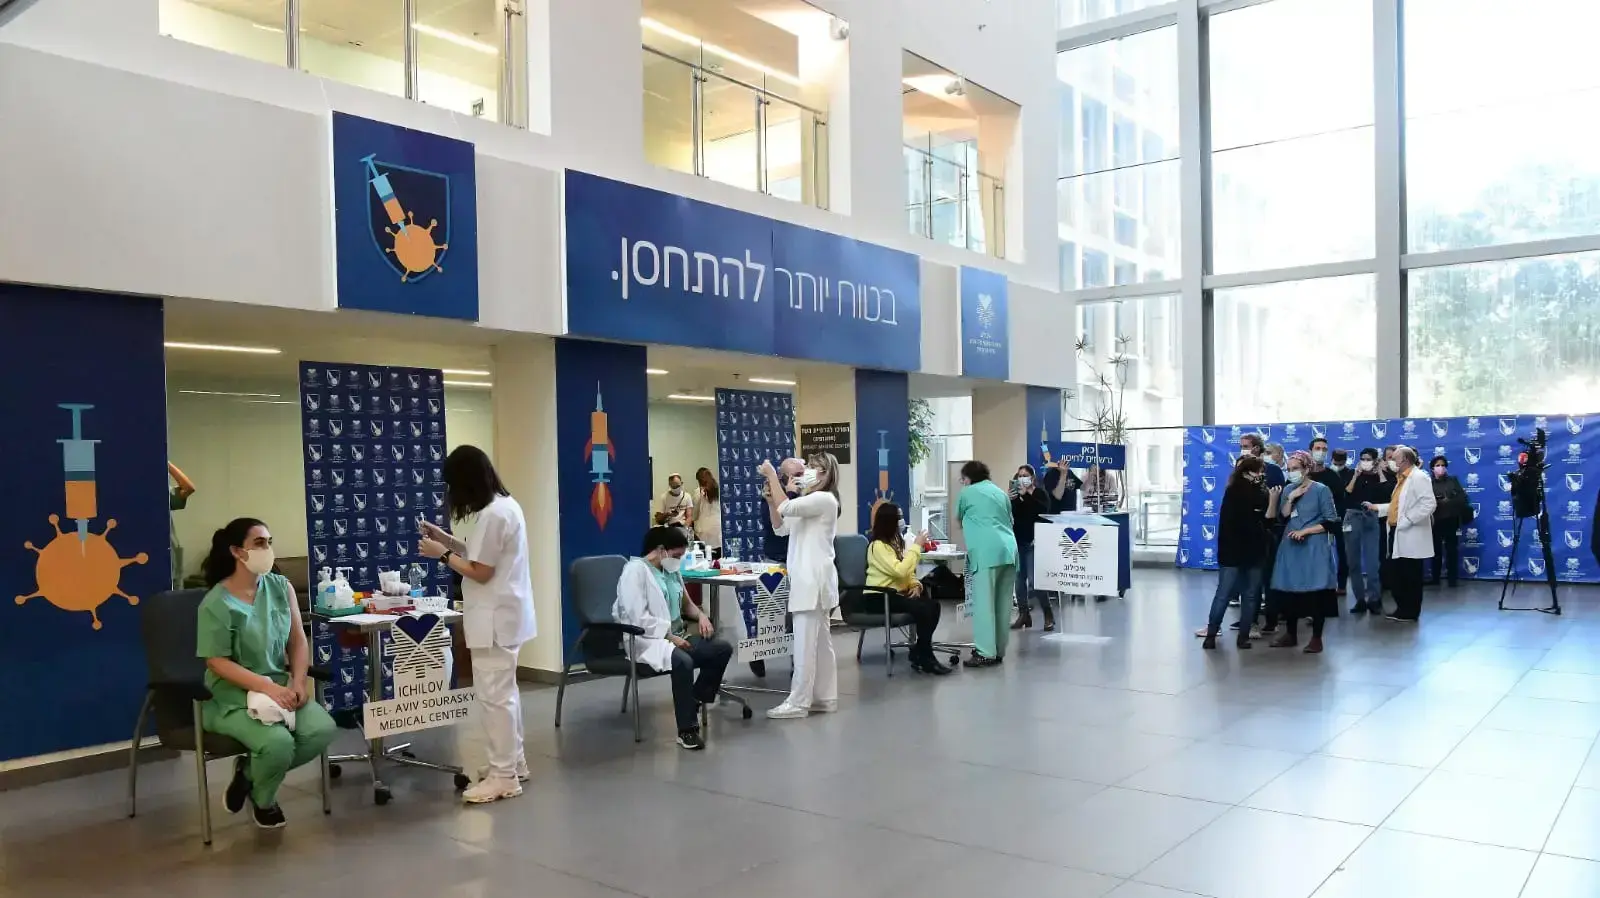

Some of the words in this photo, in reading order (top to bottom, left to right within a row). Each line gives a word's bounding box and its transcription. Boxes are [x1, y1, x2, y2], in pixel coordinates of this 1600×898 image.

[611, 236, 766, 303] להתחסן.
[774, 267, 829, 313] יותר
[838, 280, 898, 326] בטוח
[1081, 446, 1095, 455] כאן
[760, 624, 784, 635] איכילוב
[398, 680, 443, 698] ICHILOV
[370, 706, 392, 718] TEL-
[395, 700, 419, 714] AVIV
[422, 692, 476, 709] SOURASKY
[379, 713, 426, 731] MEDICAL
[429, 707, 469, 722] CENTER
